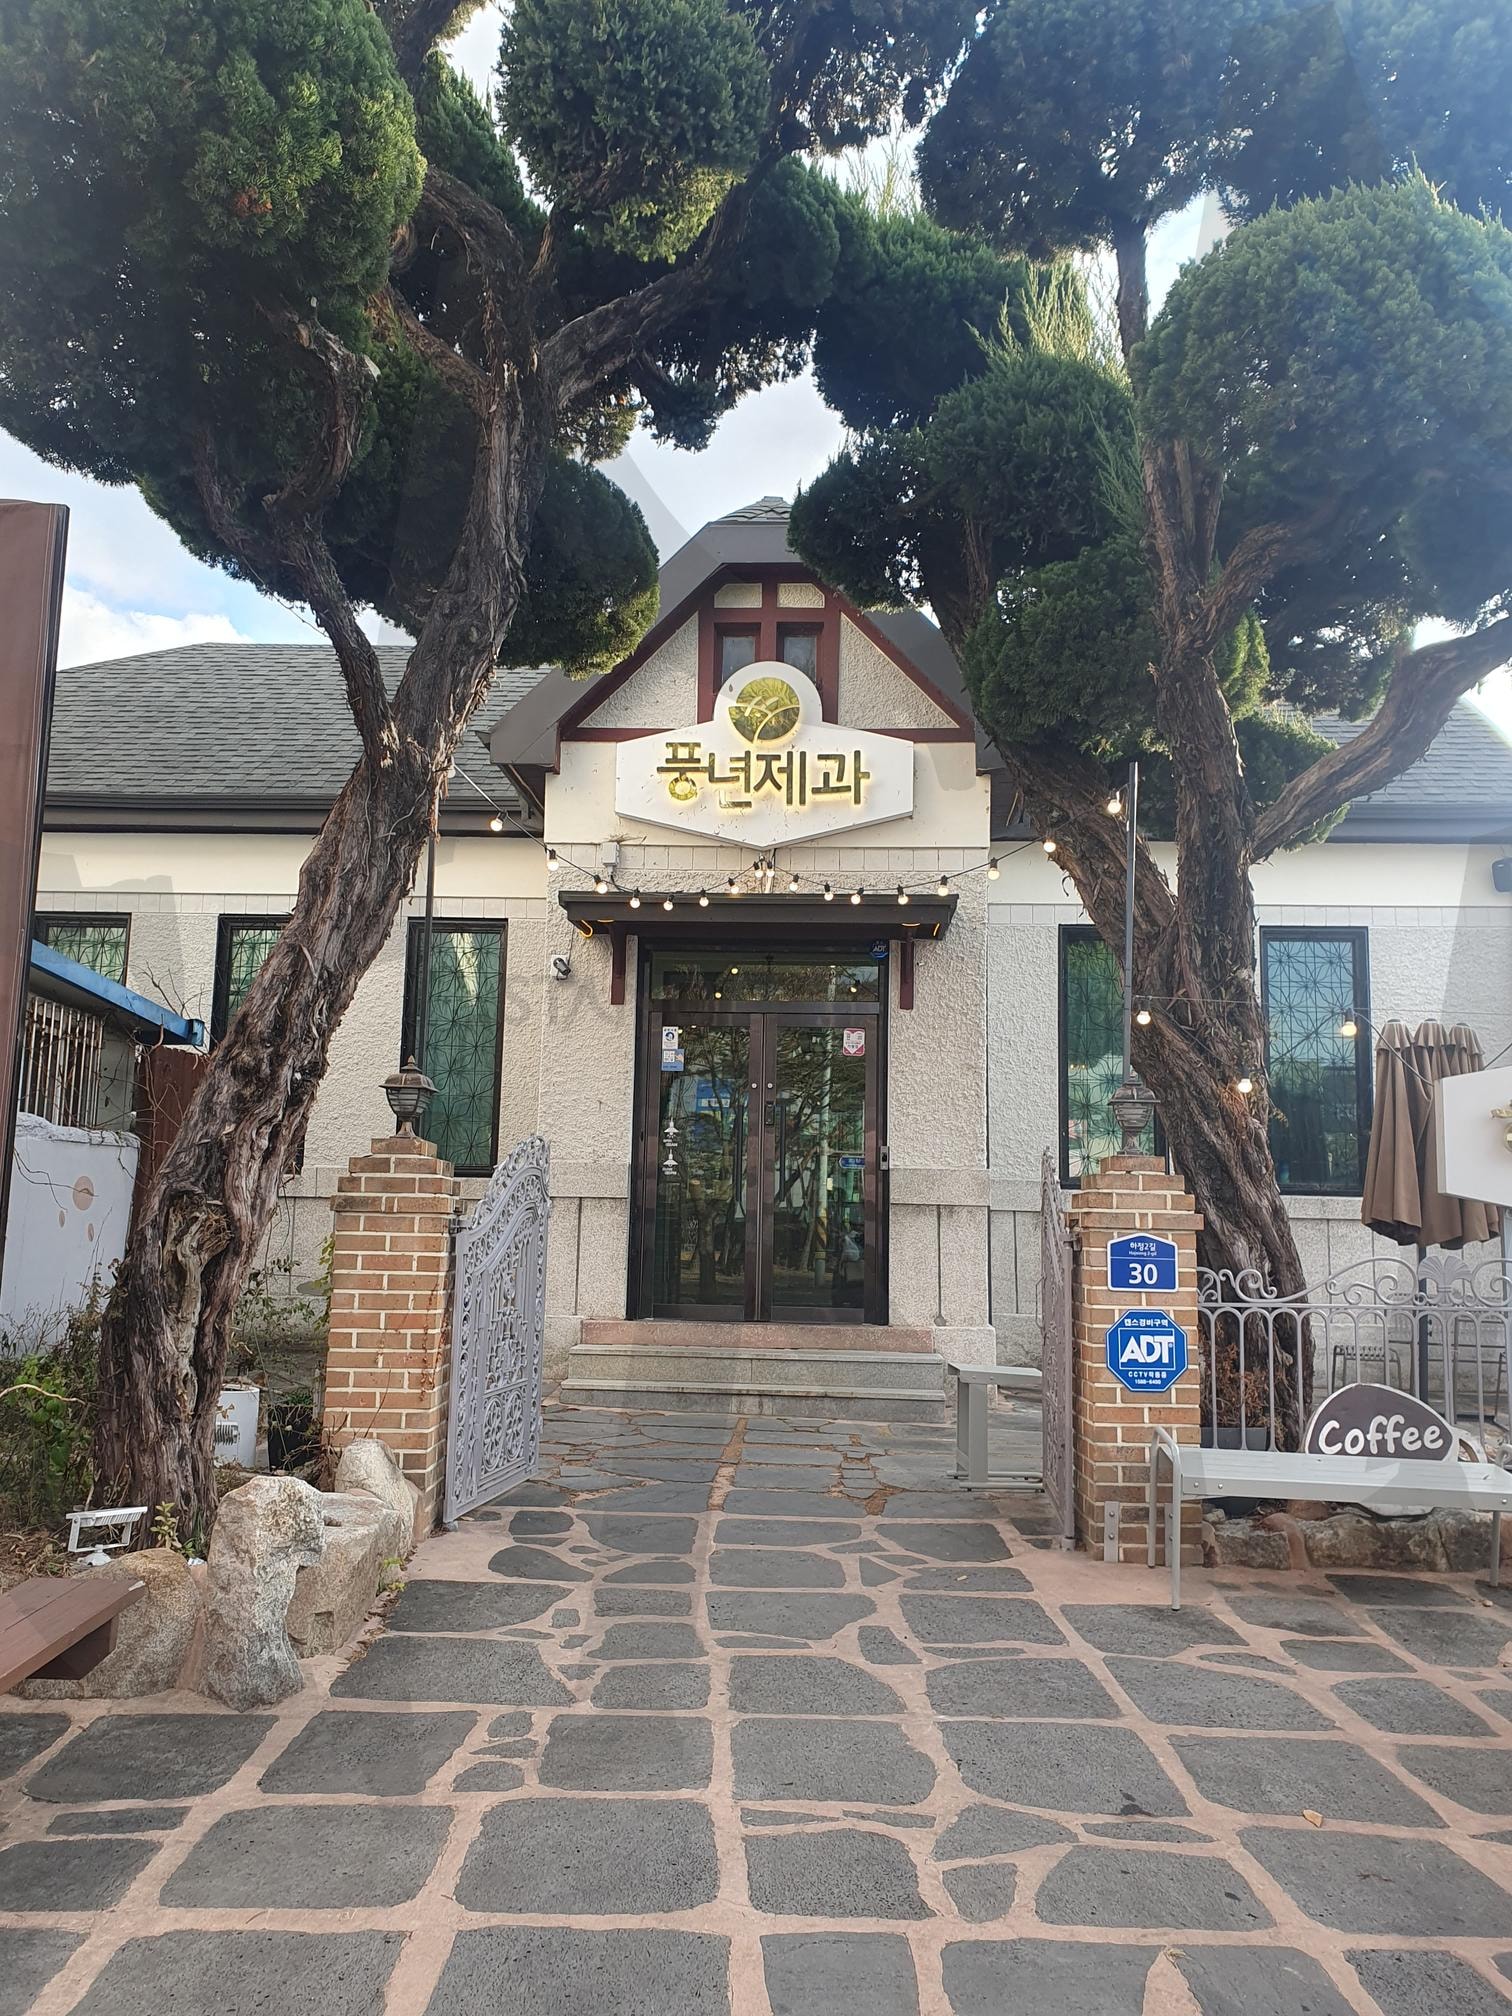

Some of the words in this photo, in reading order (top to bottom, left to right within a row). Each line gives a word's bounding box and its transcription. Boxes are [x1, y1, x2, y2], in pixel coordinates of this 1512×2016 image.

[656, 742, 871, 809] 풍년제과
[1129, 1241, 1156, 1252] 하정2길
[1128, 1263, 1158, 1285] 30
[1119, 1334, 1174, 1363] ADT
[1318, 1414, 1444, 1455] Coffee
